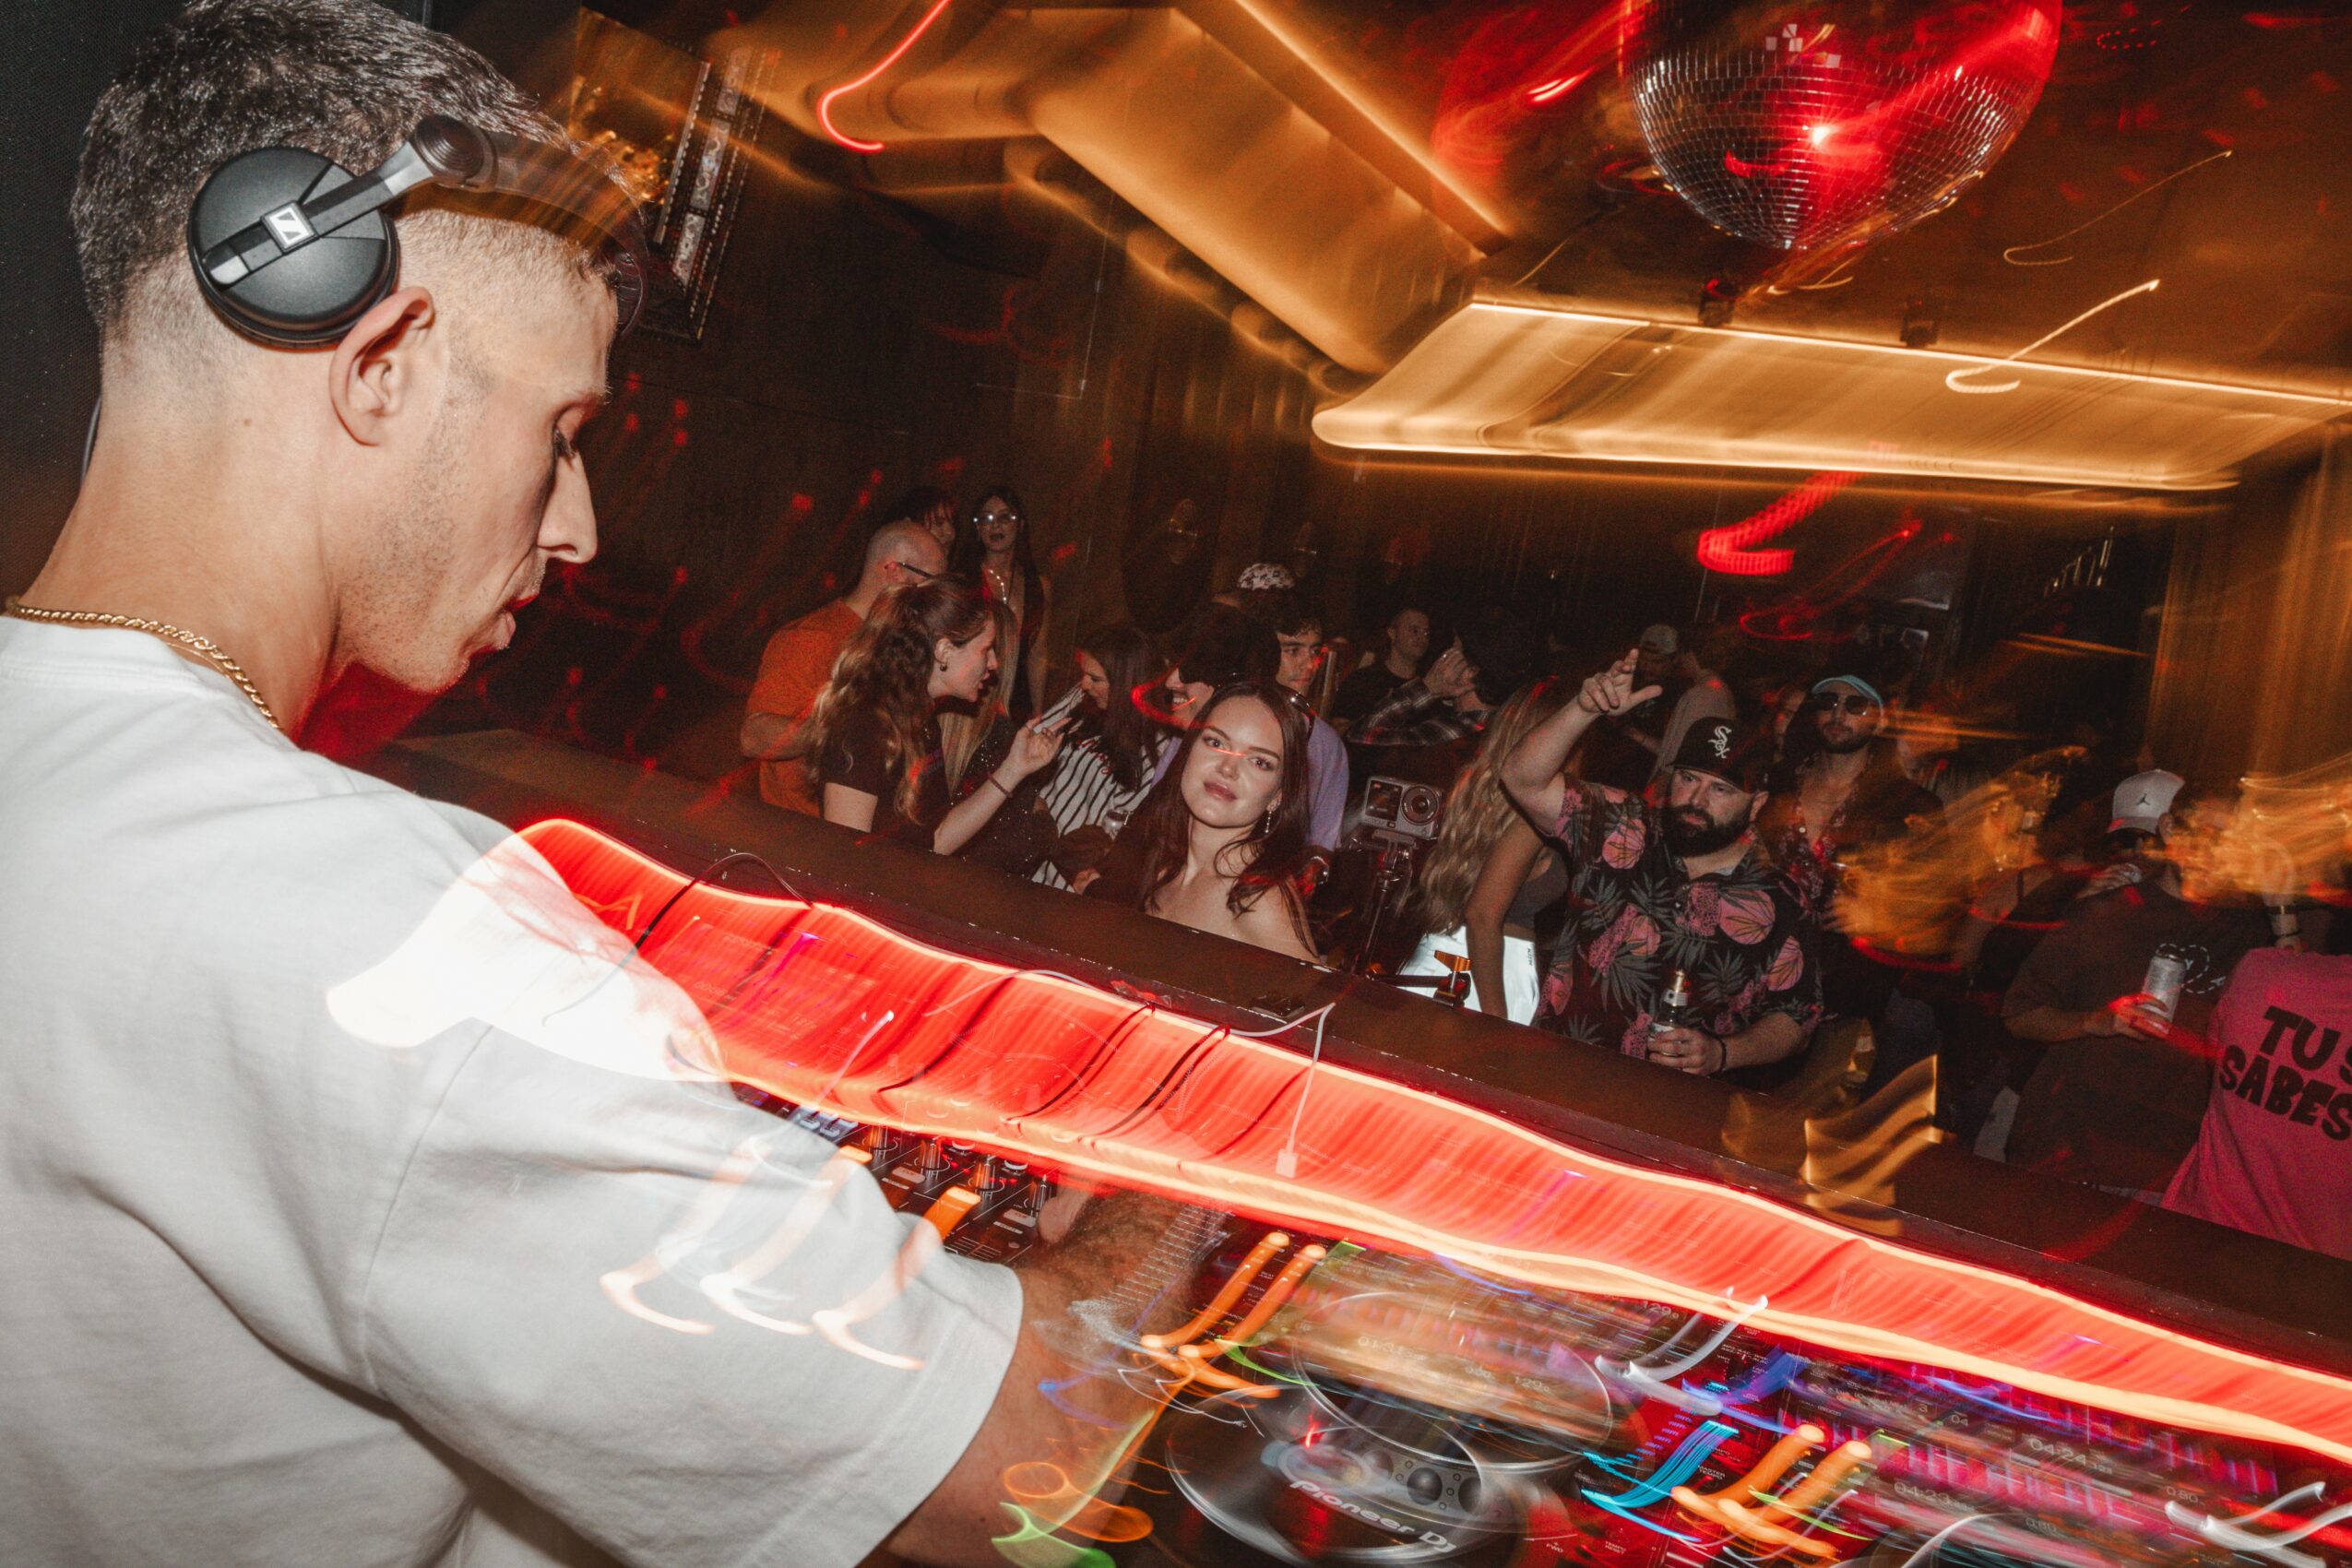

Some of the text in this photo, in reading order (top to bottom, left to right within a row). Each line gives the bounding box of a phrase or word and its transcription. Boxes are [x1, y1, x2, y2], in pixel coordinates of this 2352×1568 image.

[2261, 1005, 2341, 1071] TU
[2219, 1044, 2352, 1140] SABES
[1289, 1479, 1416, 1533] Pioneer
[1546, 1542, 1564, 1553] FWD
